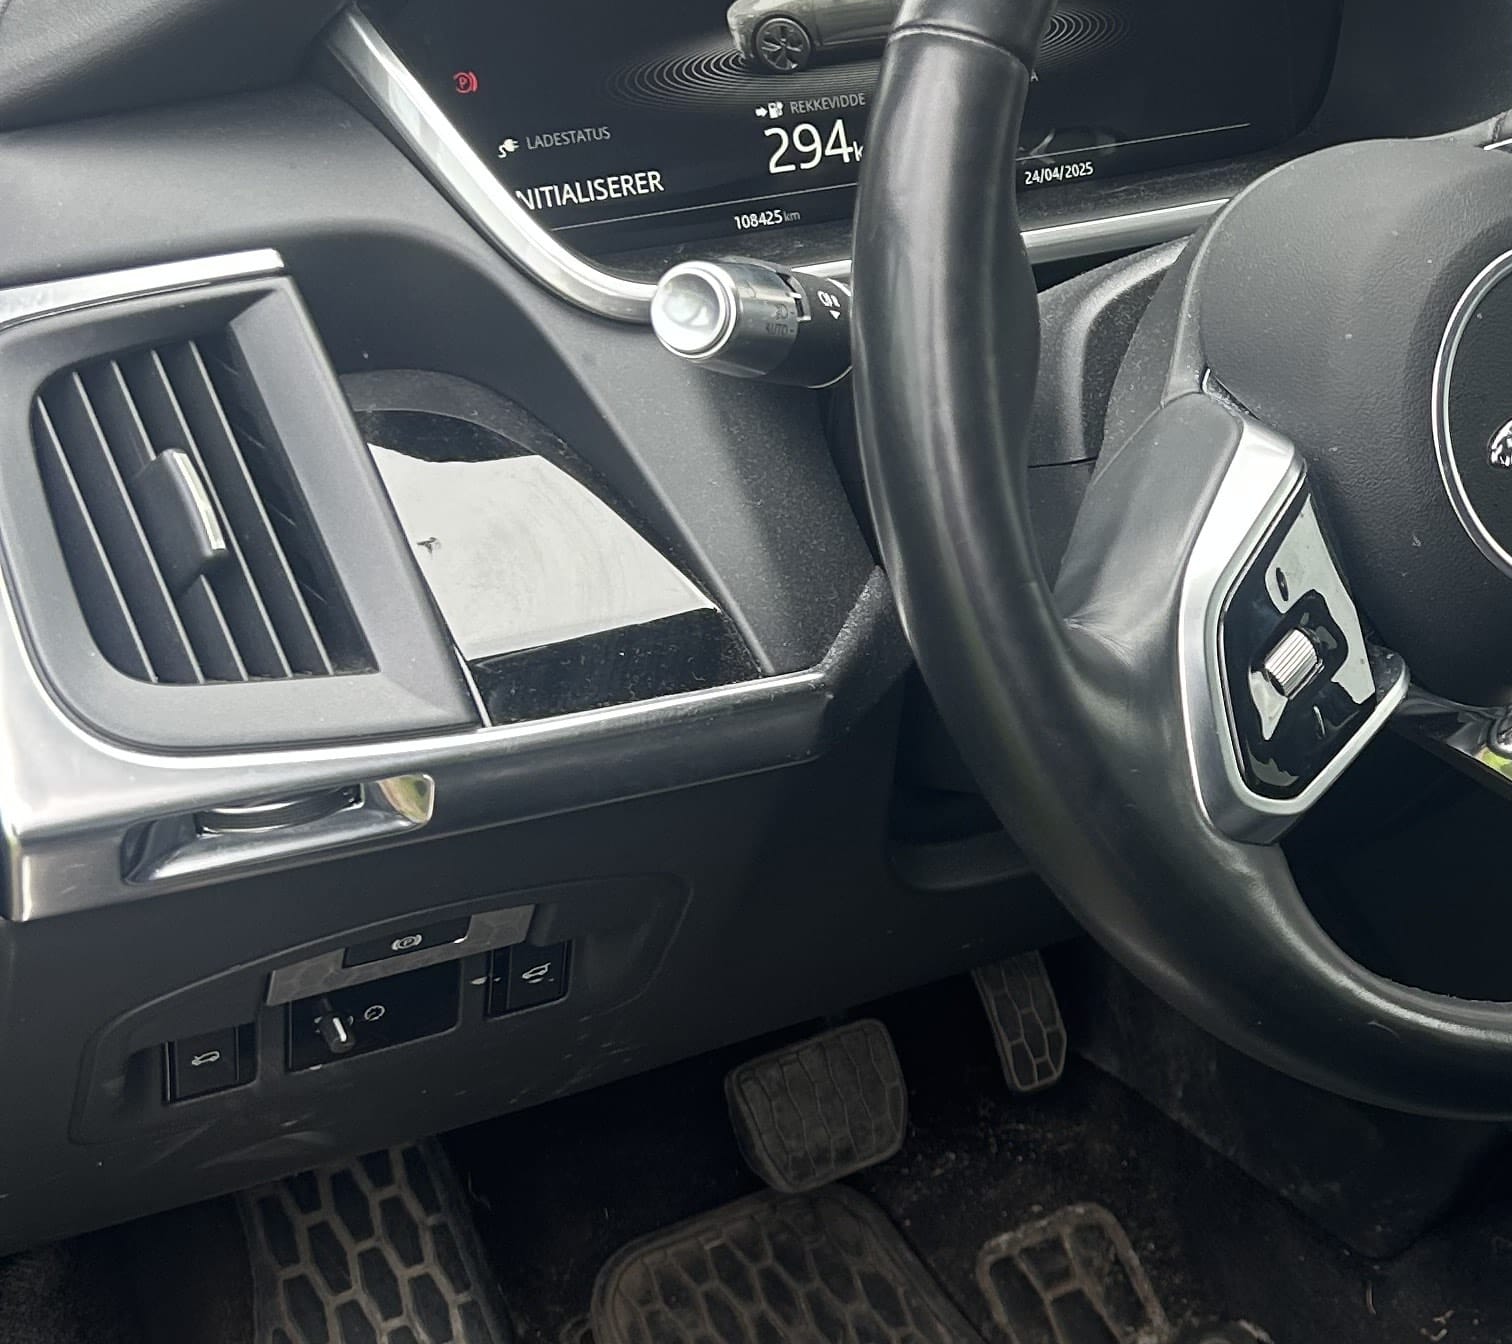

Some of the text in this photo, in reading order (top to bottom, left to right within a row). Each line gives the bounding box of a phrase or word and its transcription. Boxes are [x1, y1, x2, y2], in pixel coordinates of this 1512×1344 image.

[790, 93, 866, 114] REKKEVIDDE
[526, 126, 611, 150] LADESTATUS
[1024, 161, 1094, 185] 24/04/2025
